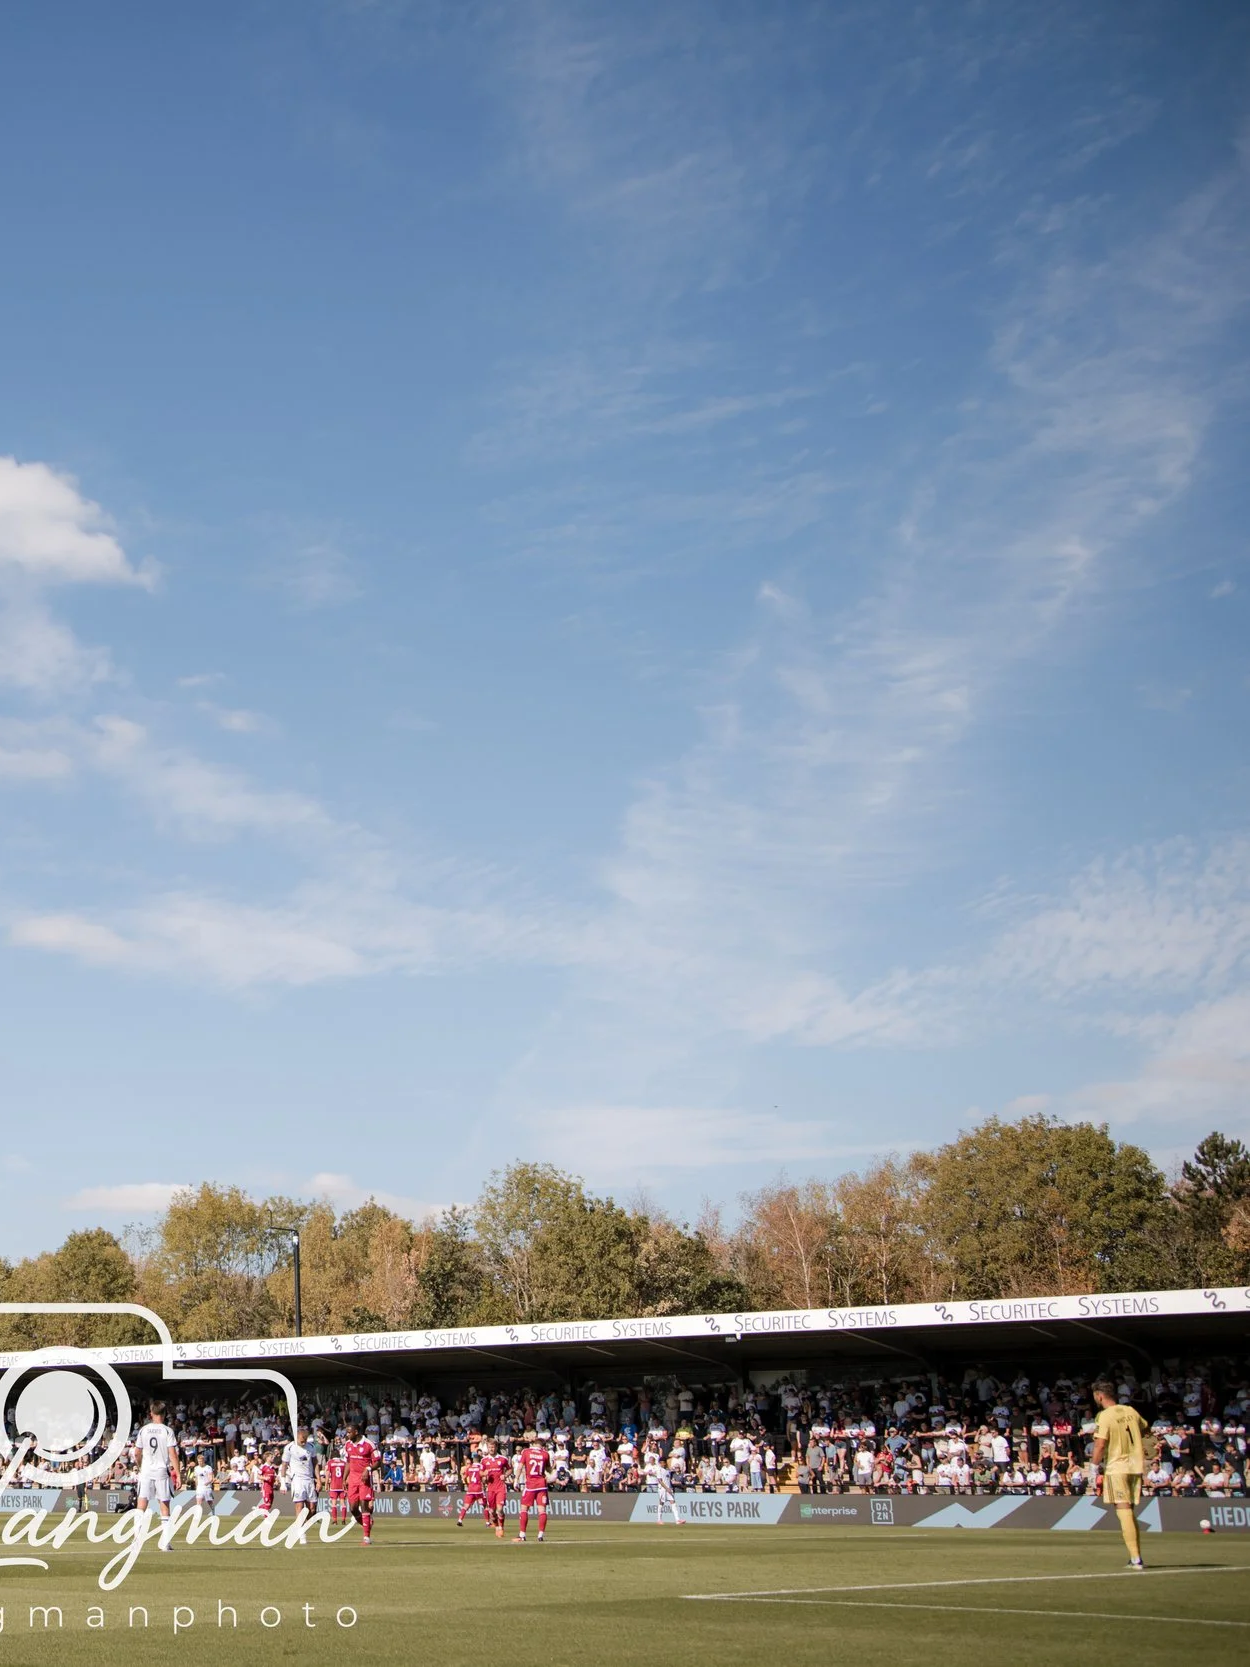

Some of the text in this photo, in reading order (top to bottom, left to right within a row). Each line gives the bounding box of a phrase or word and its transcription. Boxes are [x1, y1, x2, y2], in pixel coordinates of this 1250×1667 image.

[1126, 1425, 1134, 1445] 1
[149, 1437, 158, 1454] 9
[335, 1467, 342, 1478] 8
[529, 1460, 544, 1475] 21
[470, 1471, 477, 1483] 4
[1, 1495, 21, 1508] KEYS
[23, 1496, 42, 1508] PARK
[417, 1498, 432, 1513] VS
[546, 1500, 602, 1516] ATHLETIC
[680, 1505, 687, 1514] TO
[690, 1501, 723, 1517] KEYS
[727, 1502, 760, 1518] PARK
[802, 1504, 858, 1518] enterprise
[1210, 1507, 1250, 1526] HED
